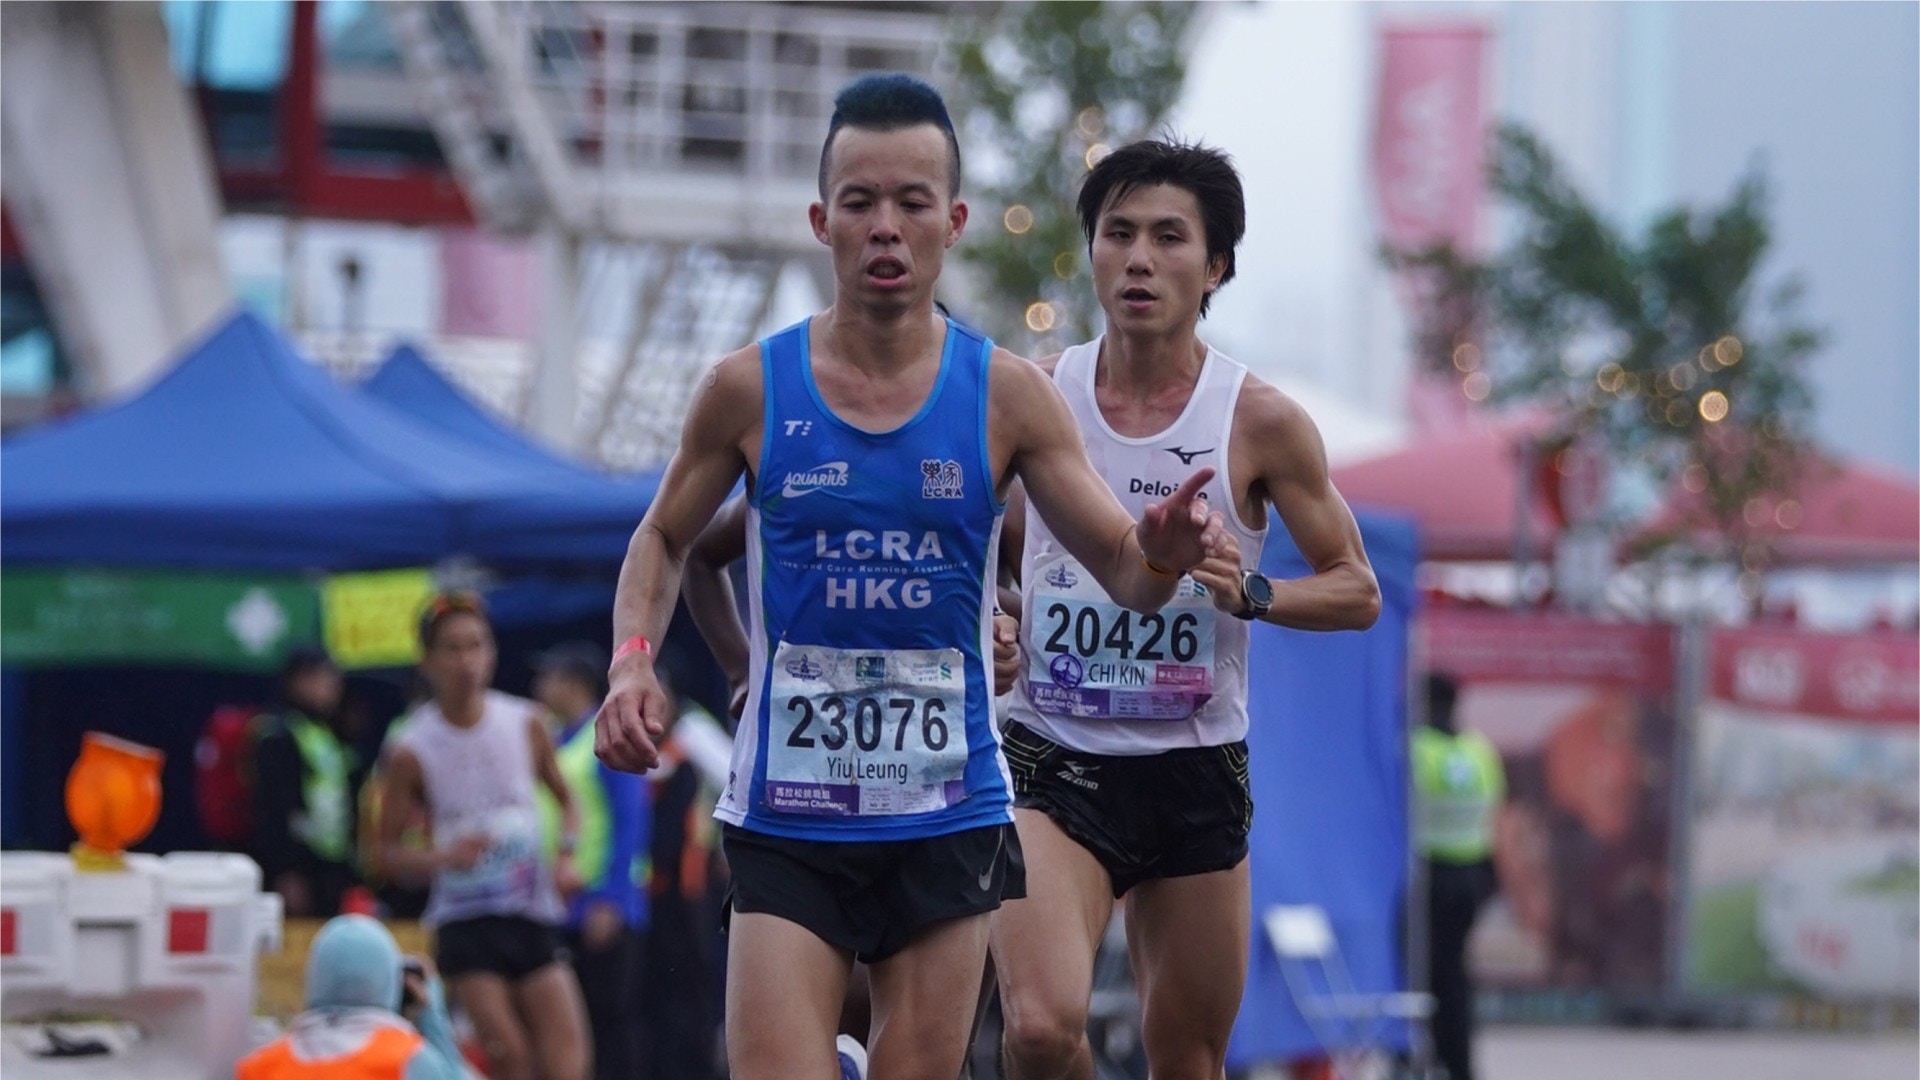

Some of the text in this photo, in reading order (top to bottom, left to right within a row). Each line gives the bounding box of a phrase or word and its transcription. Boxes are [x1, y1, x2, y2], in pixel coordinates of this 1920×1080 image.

[923, 487, 963, 498] LCRA
[1129, 478, 1209, 501] Deloie
[815, 530, 944, 561] LCRA
[827, 564, 854, 573] Care
[859, 564, 908, 575] Running
[826, 577, 932, 609] HKG
[1044, 603, 1198, 662] 20426
[1088, 663, 1116, 684] CHI
[1119, 664, 1146, 686] KIN
[1066, 701, 1099, 713] Cenge
[786, 695, 949, 752] 23076
[827, 756, 908, 785] Yiu Leung
[774, 797, 809, 807] Marathon
